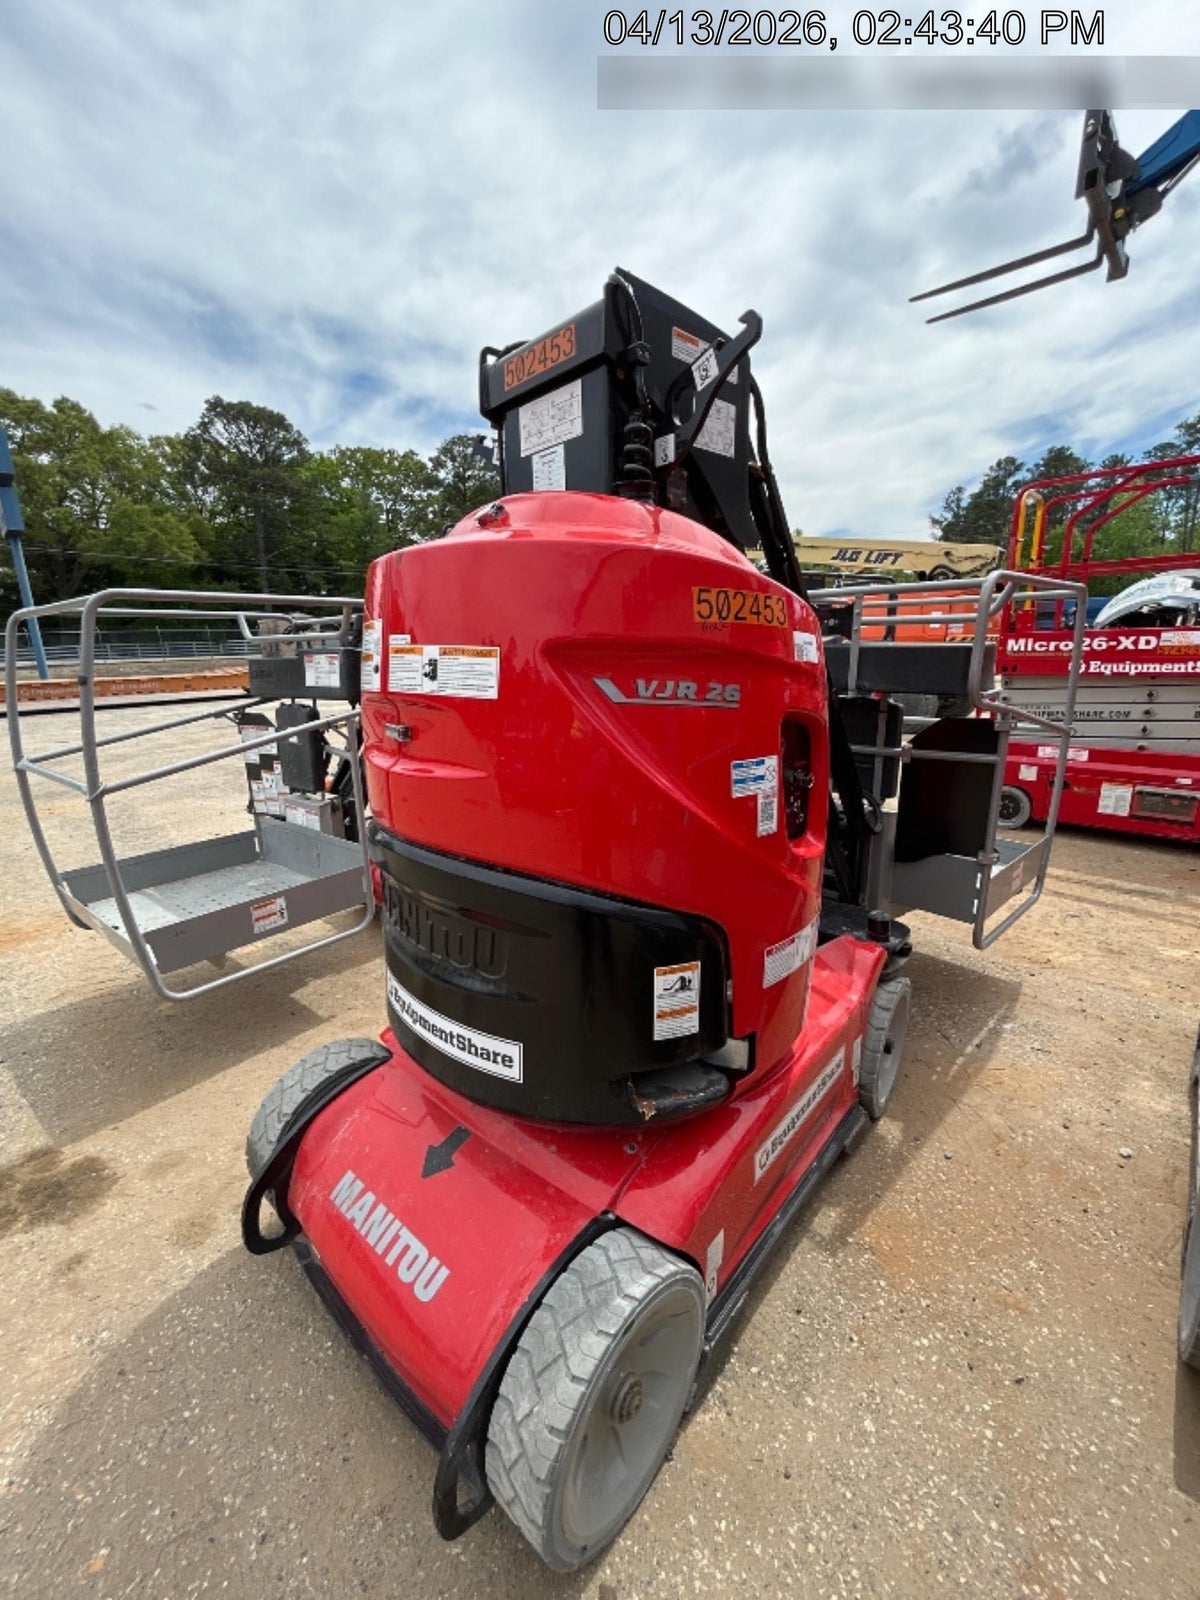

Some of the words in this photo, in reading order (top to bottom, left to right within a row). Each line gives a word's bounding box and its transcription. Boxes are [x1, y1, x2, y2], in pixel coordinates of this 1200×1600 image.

[505, 325, 575, 387] 502453
[830, 548, 863, 563] JLG
[864, 550, 904, 566] LIFT
[696, 587, 787, 627] 502453
[635, 678, 698, 701] VJR
[704, 682, 741, 703] 26
[391, 984, 515, 1069] EquipmentShare
[329, 1169, 451, 1303] MANITOU
